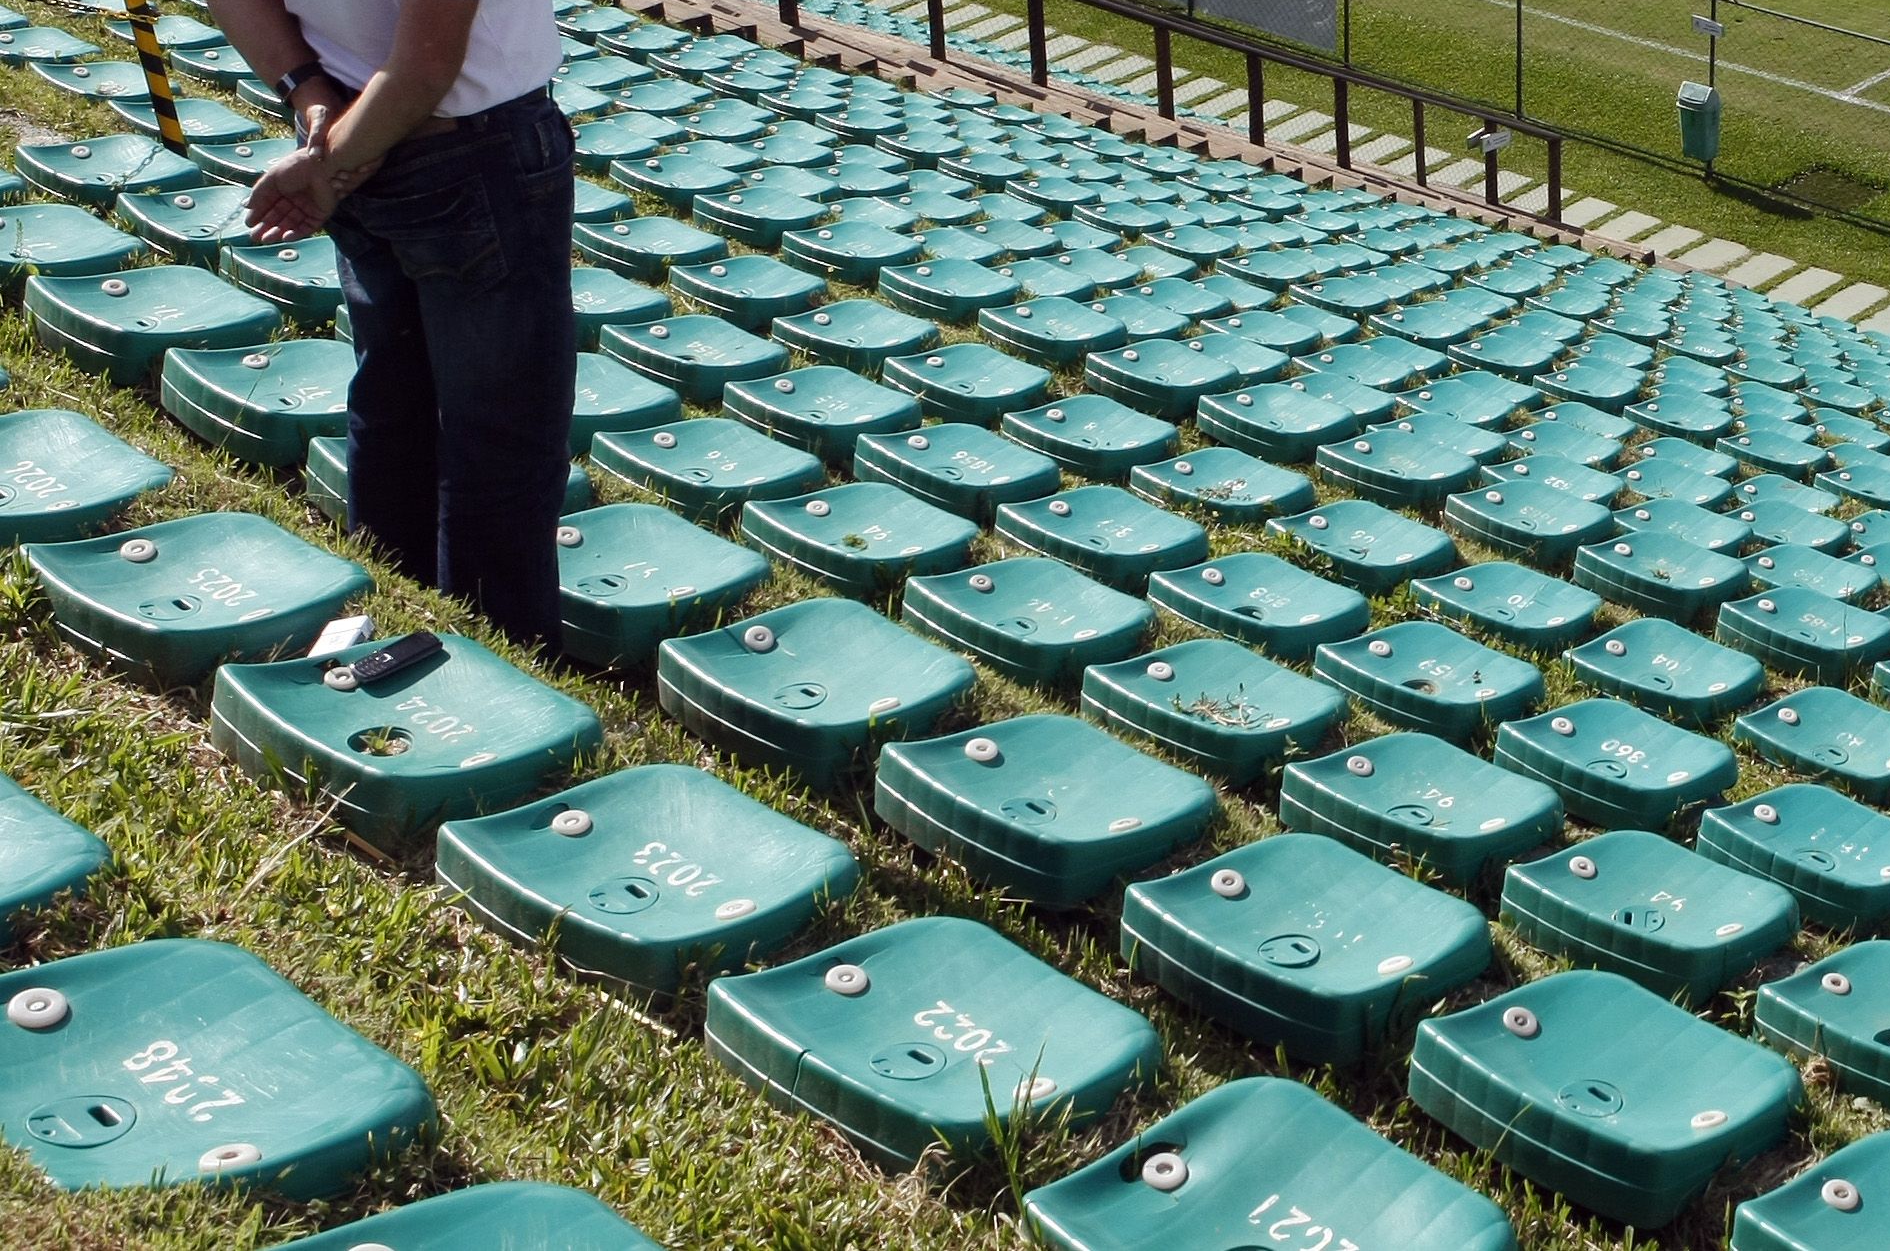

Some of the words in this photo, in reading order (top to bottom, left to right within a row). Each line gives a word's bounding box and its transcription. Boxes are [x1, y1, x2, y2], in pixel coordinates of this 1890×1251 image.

[5, 460, 67, 498] 2026
[196, 567, 258, 607] 2025
[632, 841, 720, 896] 2023
[913, 1000, 1012, 1064] 2022
